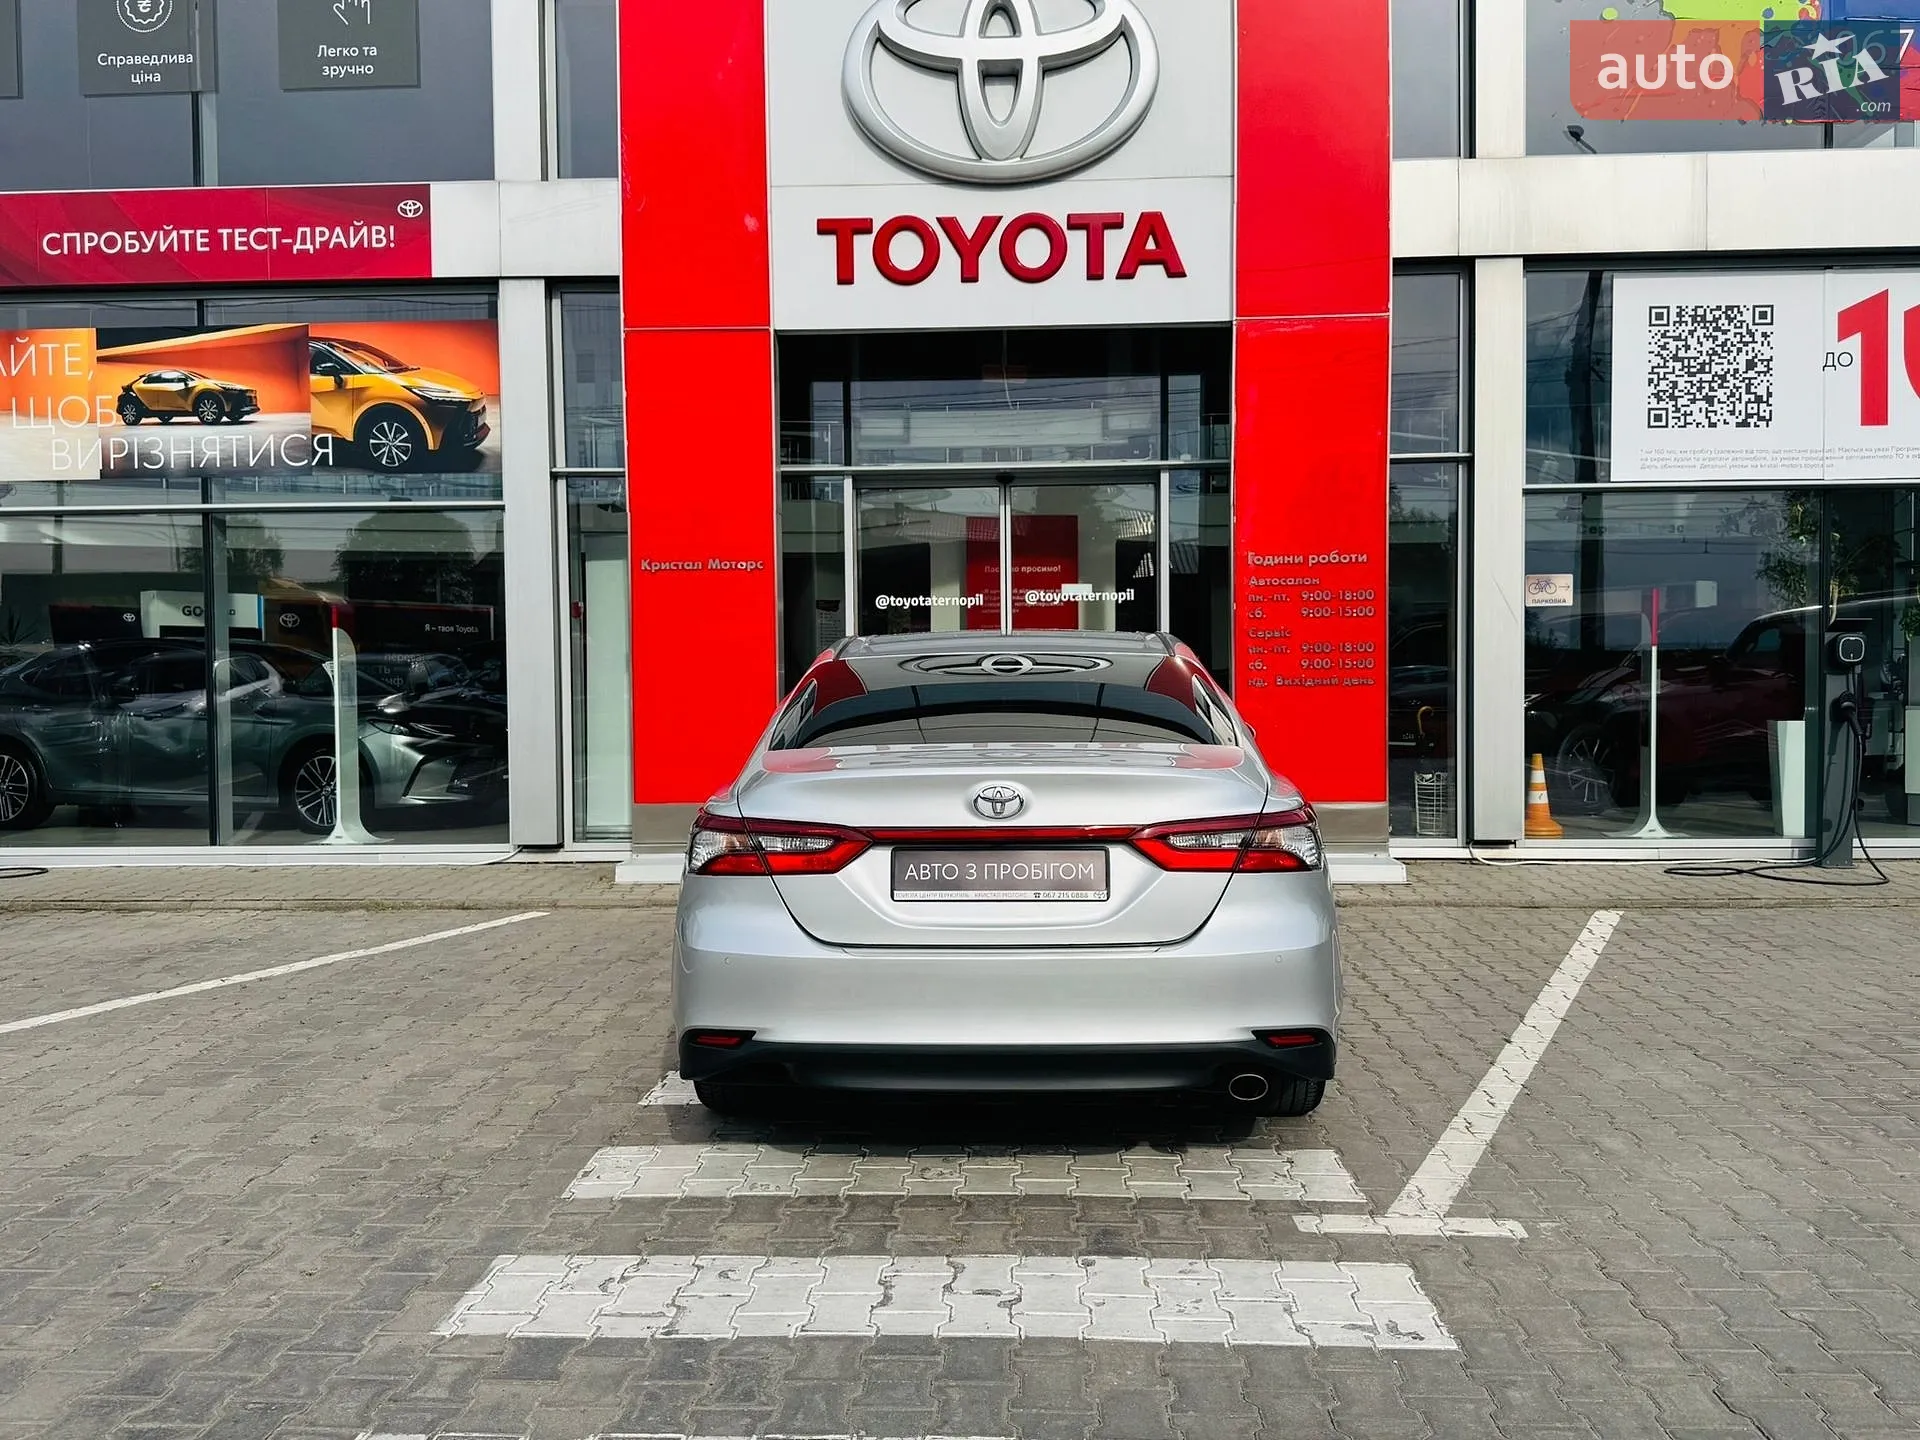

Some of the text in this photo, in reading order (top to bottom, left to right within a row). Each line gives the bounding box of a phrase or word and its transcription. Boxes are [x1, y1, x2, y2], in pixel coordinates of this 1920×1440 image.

[317, 44, 377, 59] Легко та
[97, 52, 194, 67] Справедлива
[130, 70, 161, 84] ціна
[321, 62, 375, 77] зручно
[42, 220, 396, 255] СПРОБУЙТЕ ТЕСТ-ДРАЙВ!
[816, 211, 1188, 286] TOYOTA
[12, 395, 116, 435] ЩОБ
[51, 433, 334, 472] ВИРІЗНЯТИСЯ
[641, 558, 763, 572] Кристал Моторс
[1247, 550, 1368, 567] Години роботи
[1248, 576, 1320, 586] Автосалон
[875, 593, 984, 610] @toyotaternopil
[1025, 588, 1135, 606] @toyotaternopil
[1248, 607, 1267, 618] сб.
[1248, 626, 1291, 639] Сервіс
[1248, 659, 1267, 670] сб.
[1248, 674, 1375, 687] нд. Вихідний день
[905, 862, 1095, 881] АВТО З ПРОБІГОМ
